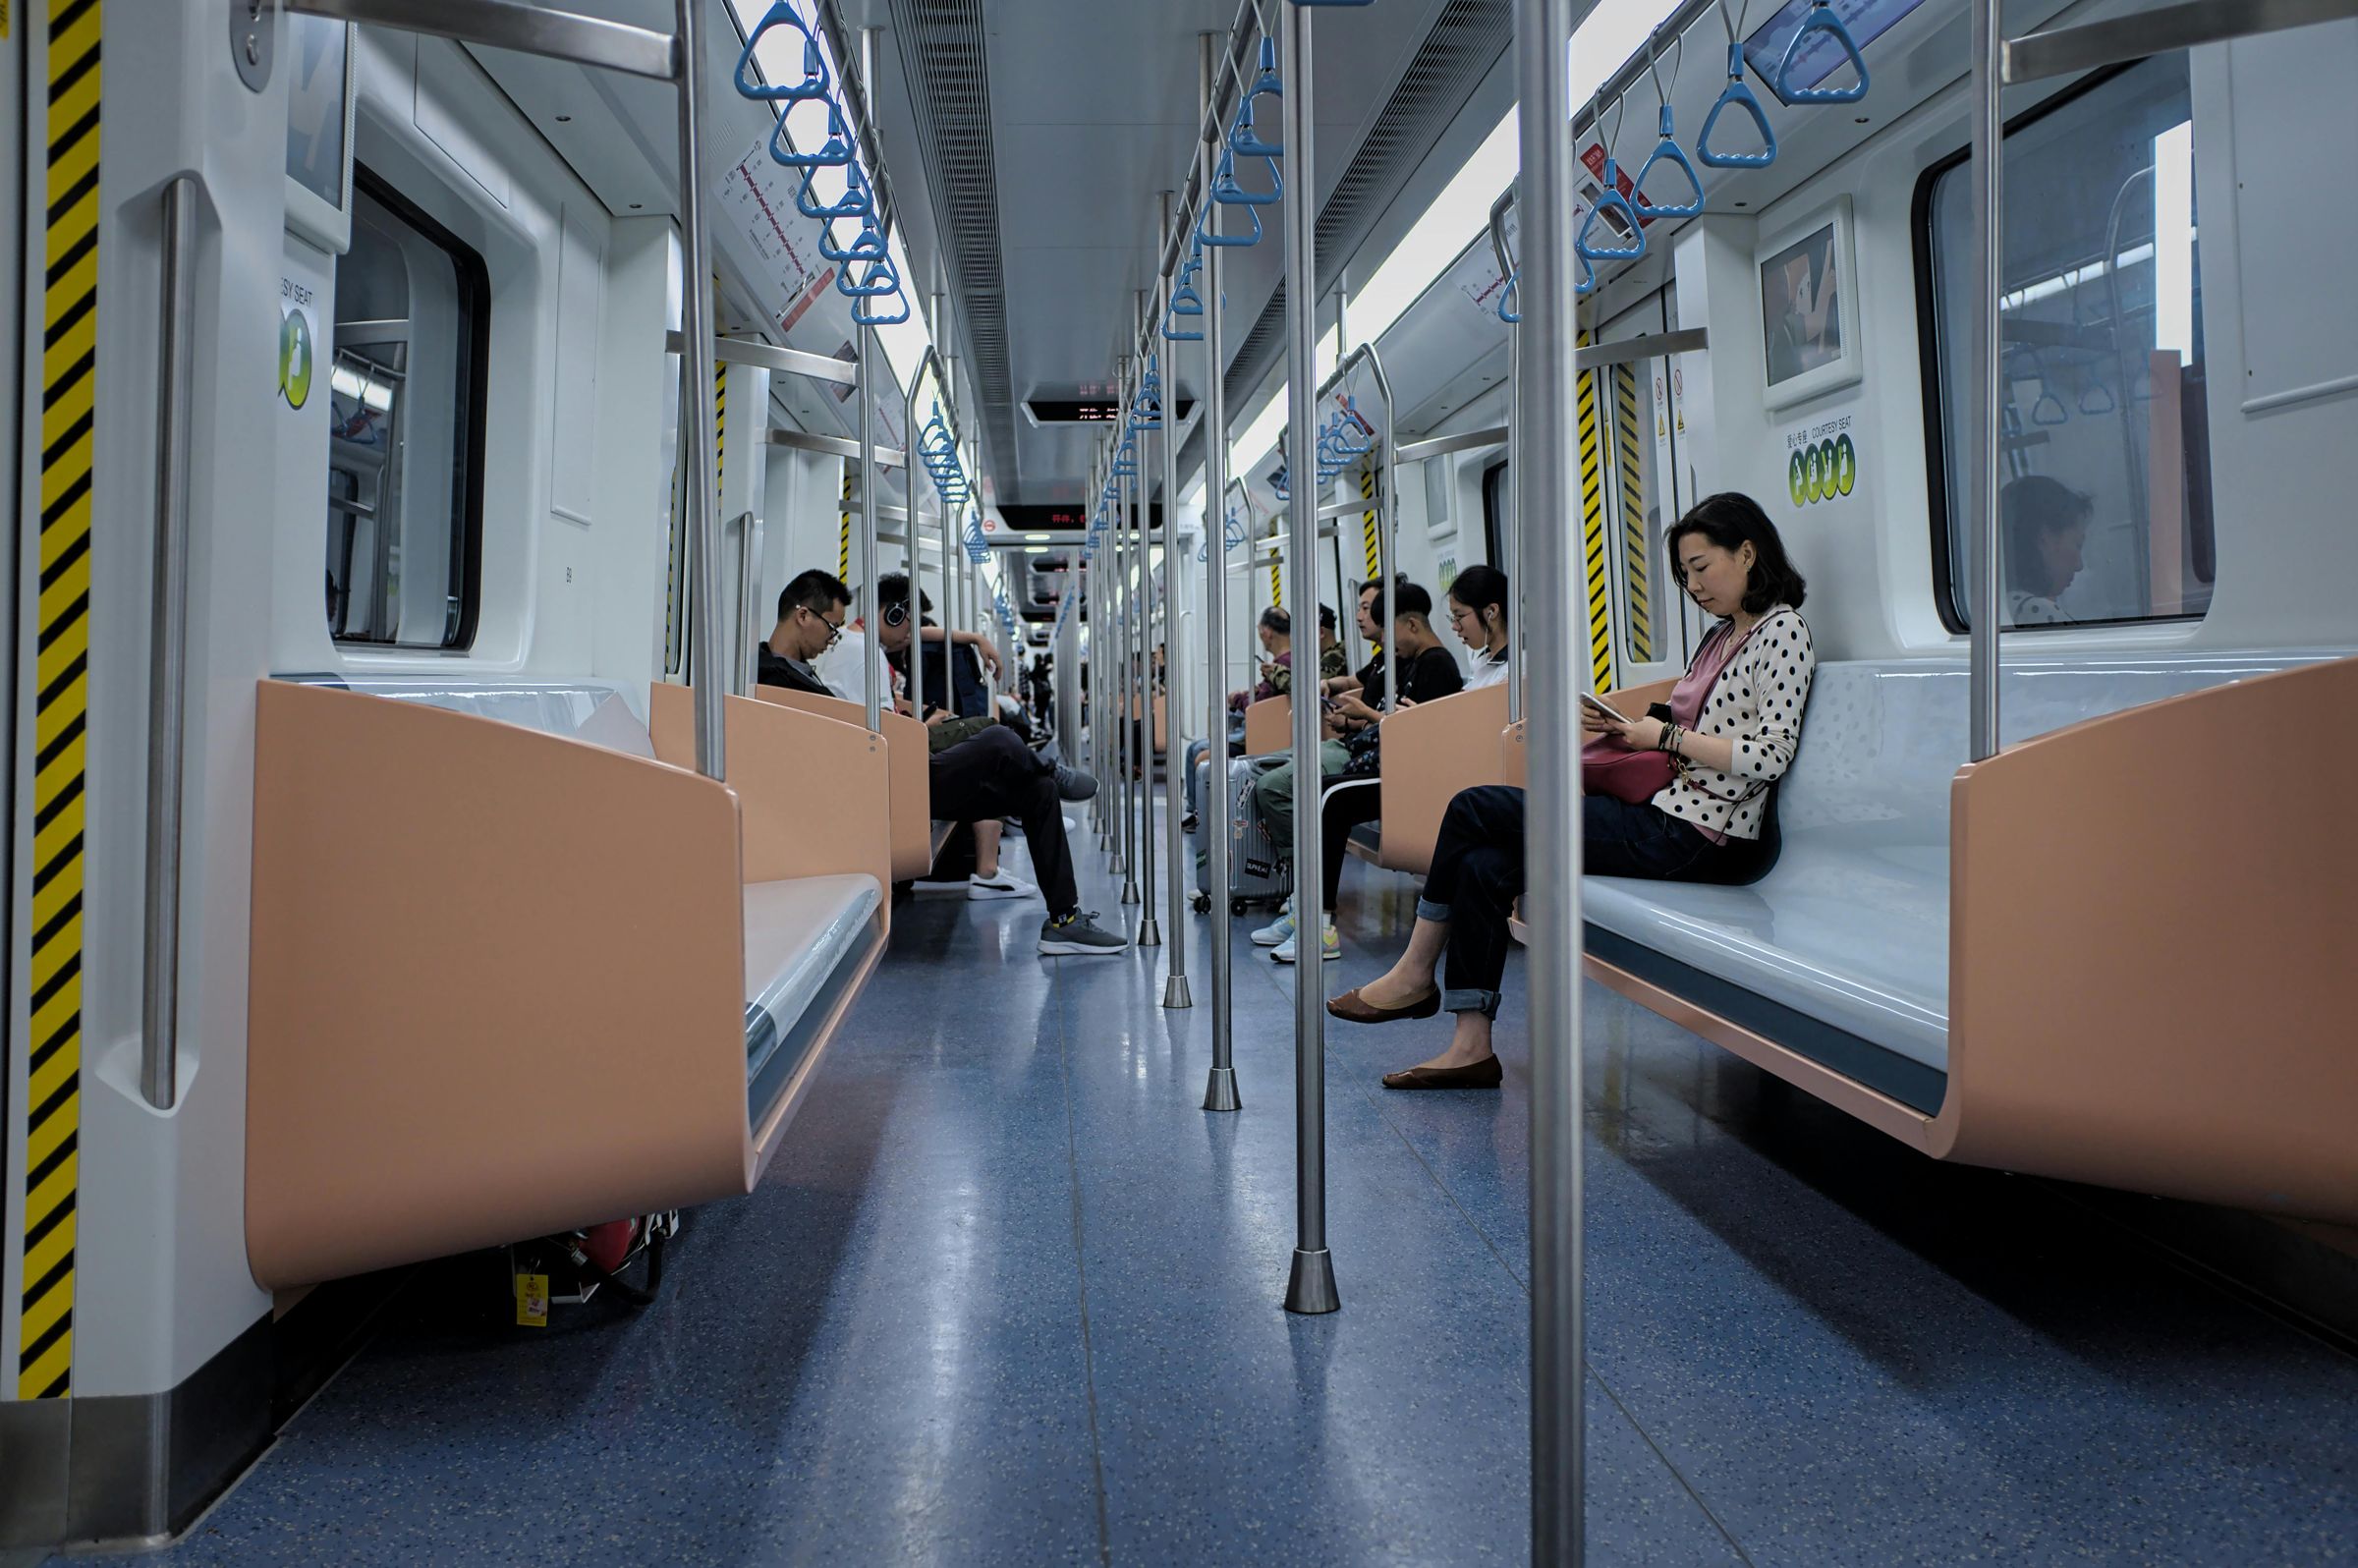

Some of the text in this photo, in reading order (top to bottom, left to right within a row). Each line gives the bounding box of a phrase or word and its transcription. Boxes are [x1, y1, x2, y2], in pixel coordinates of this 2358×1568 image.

[281, 277, 312, 307] SY SEAT
[1812, 416, 1852, 439] COURTESY SEAT
